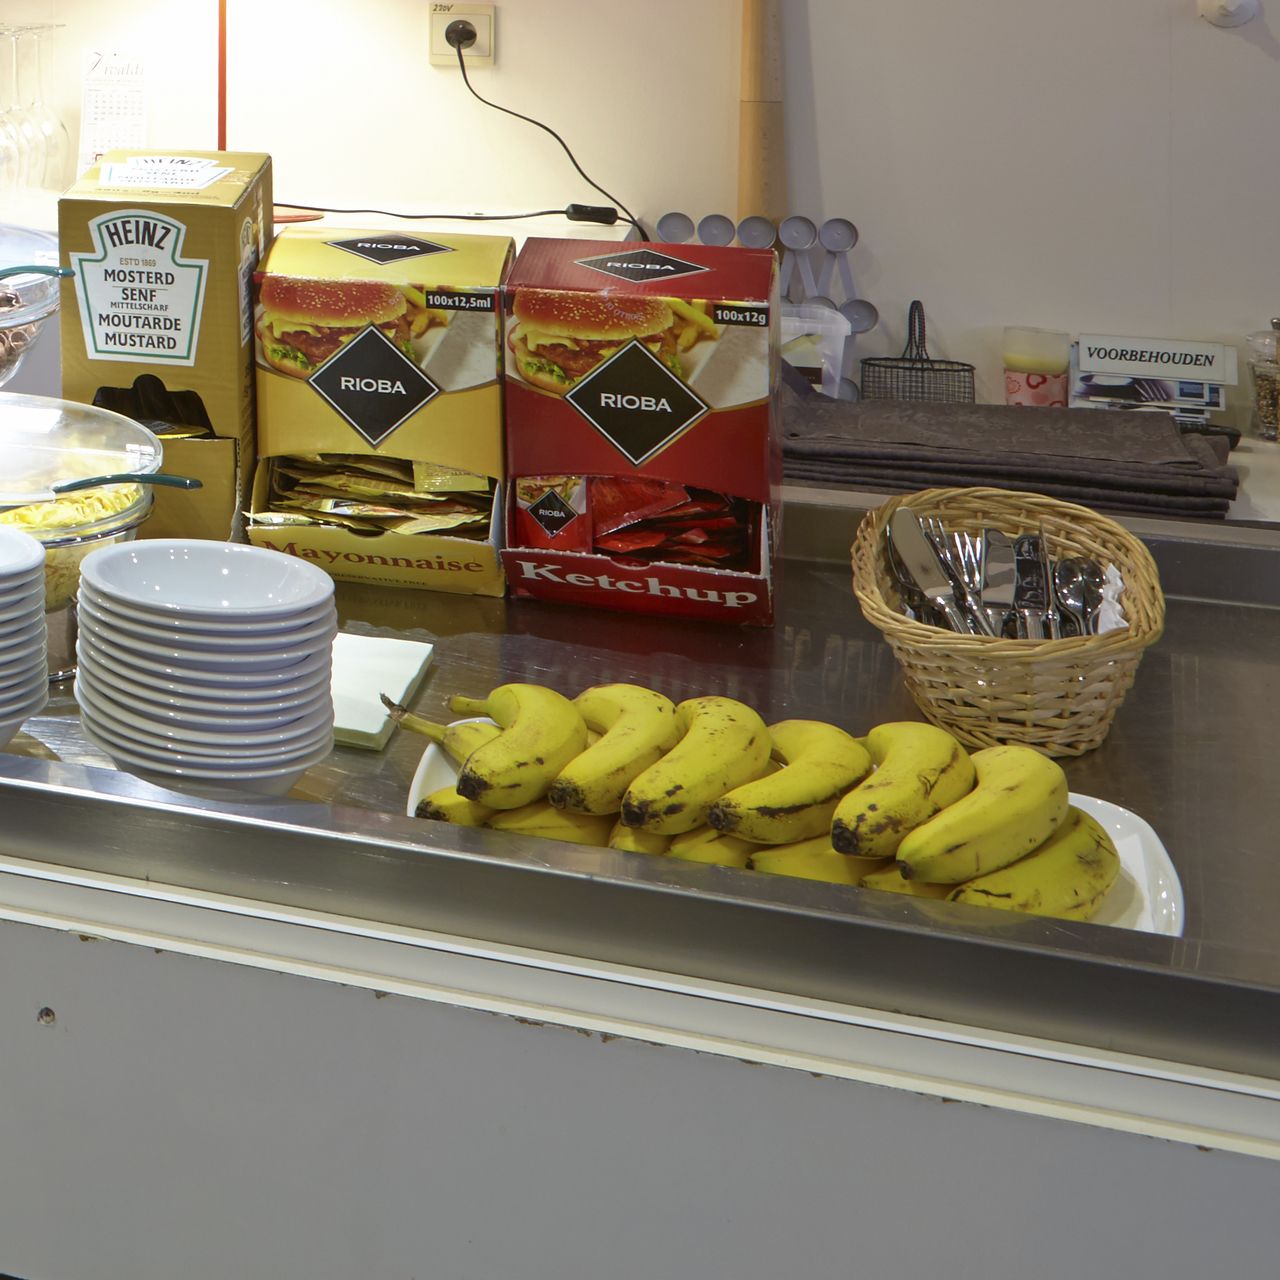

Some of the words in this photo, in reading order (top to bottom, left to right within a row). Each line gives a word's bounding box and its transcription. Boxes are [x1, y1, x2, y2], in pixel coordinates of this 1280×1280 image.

[104, 219, 172, 251] HEINZ
[357, 242, 421, 251] RIOBA
[141, 258, 157, 267] 1869
[606, 261, 676, 271] RIOBA
[103, 268, 175, 286] MOSTERD
[121, 287, 157, 302] SENF
[427, 294, 491, 308] 100x12,5ml
[110, 301, 169, 312] MITTELSCHARF
[98, 313, 182, 331] MOUTARDE
[715, 309, 767, 326] 100x12g
[104, 332, 177, 350] MUSTARD
[1087, 346, 1216, 367] VOORBEHOUDEN
[340, 376, 407, 395] RIOBA
[600, 392, 673, 413] RIOBA
[538, 509, 566, 518] RIOBA
[261, 539, 484, 574] Mayonnaise
[514, 560, 758, 607] Ketchup
